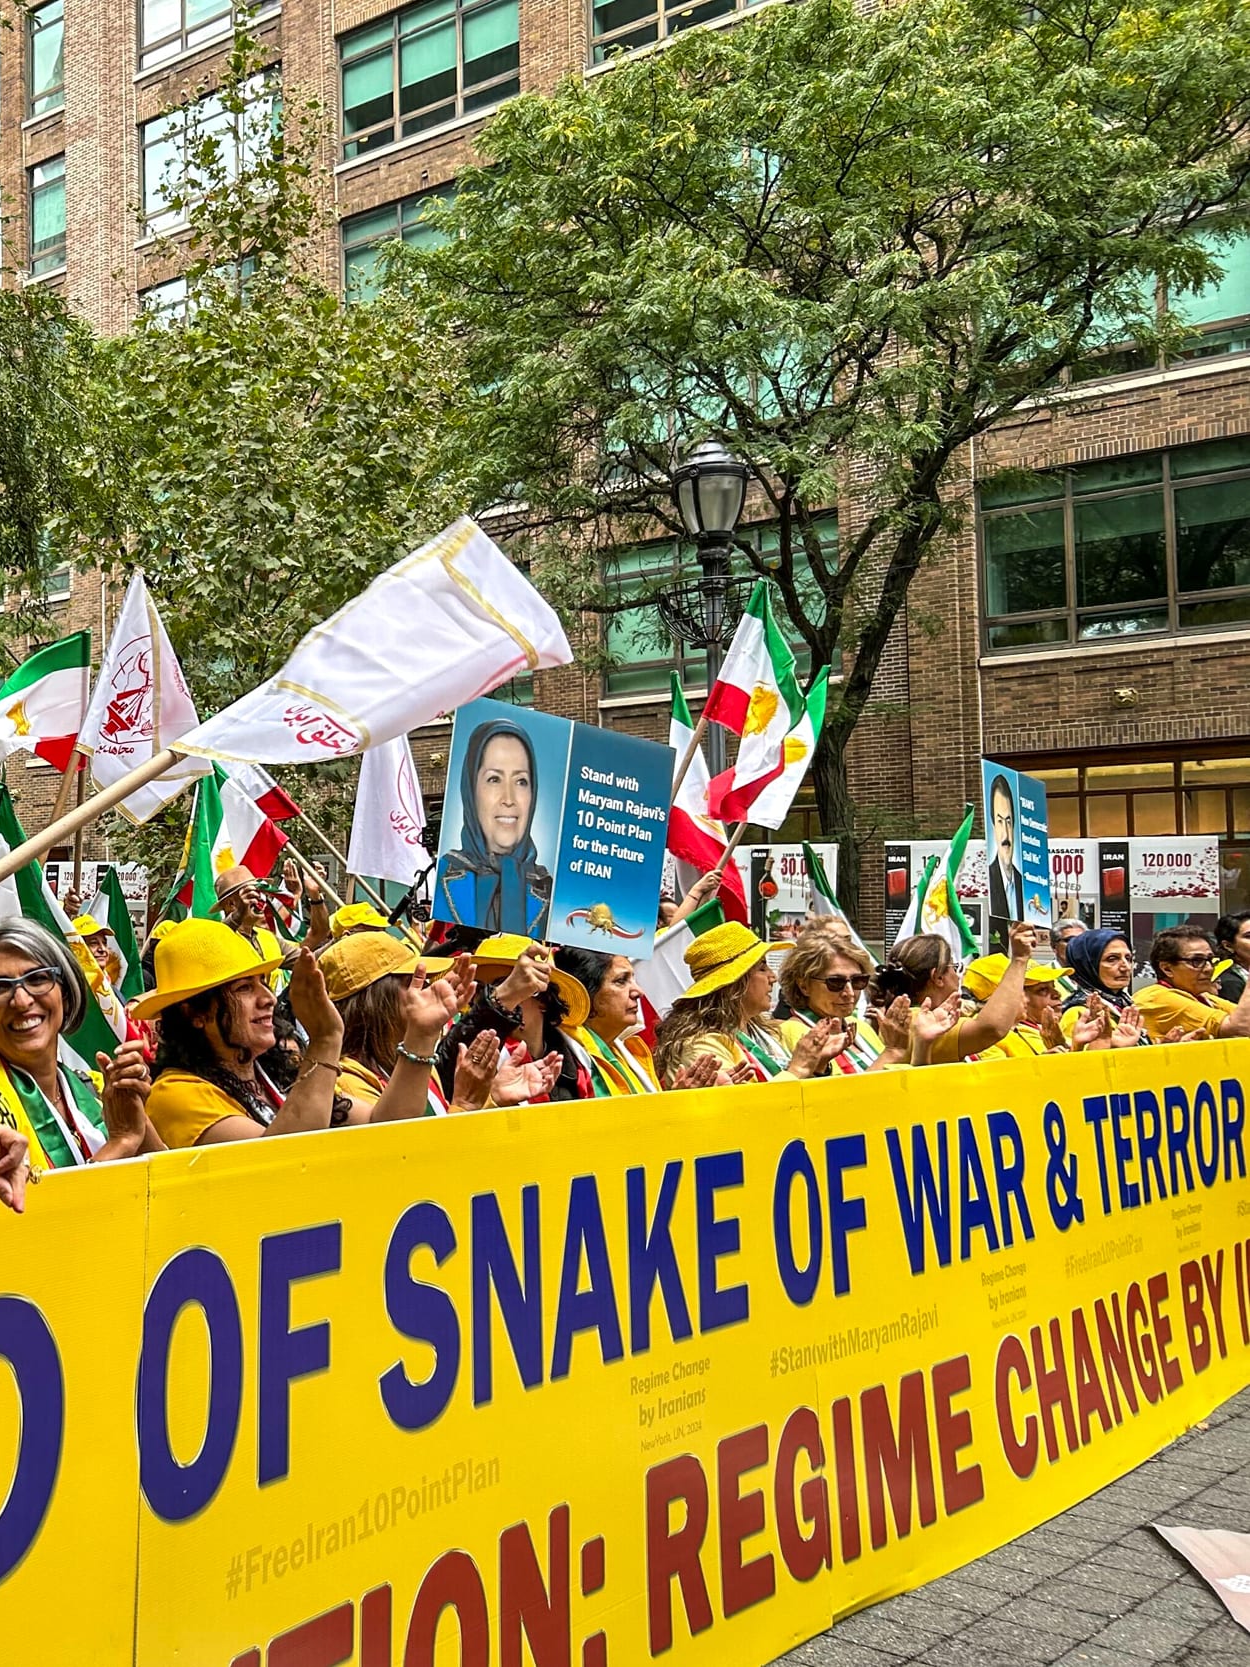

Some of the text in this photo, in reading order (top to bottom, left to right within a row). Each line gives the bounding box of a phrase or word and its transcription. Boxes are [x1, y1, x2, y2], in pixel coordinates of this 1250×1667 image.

[581, 766, 639, 792] Stand with
[578, 788, 666, 821] Maryam Rajavi's
[577, 809, 652, 842] 10 Point Plan
[573, 835, 644, 863] for the Future
[570, 859, 612, 879] of IRAN
[137, 1219, 342, 1523] OF
[378, 1150, 749, 1431] SNAKE
[773, 1132, 867, 1306] OF
[885, 1109, 1036, 1275] WAR
[1043, 1101, 1084, 1231] &
[1083, 1078, 1247, 1216] TERROR
[630, 1358, 710, 1395] Regime Change
[639, 1387, 706, 1428] by Iranians
[687, 1420, 702, 1436] 2024
[646, 1353, 984, 1658] REGIME
[996, 1272, 1183, 1480] CHANGE
[1180, 1248, 1227, 1375] BY
[226, 1457, 500, 1600] #FreeIran10PointPlan
